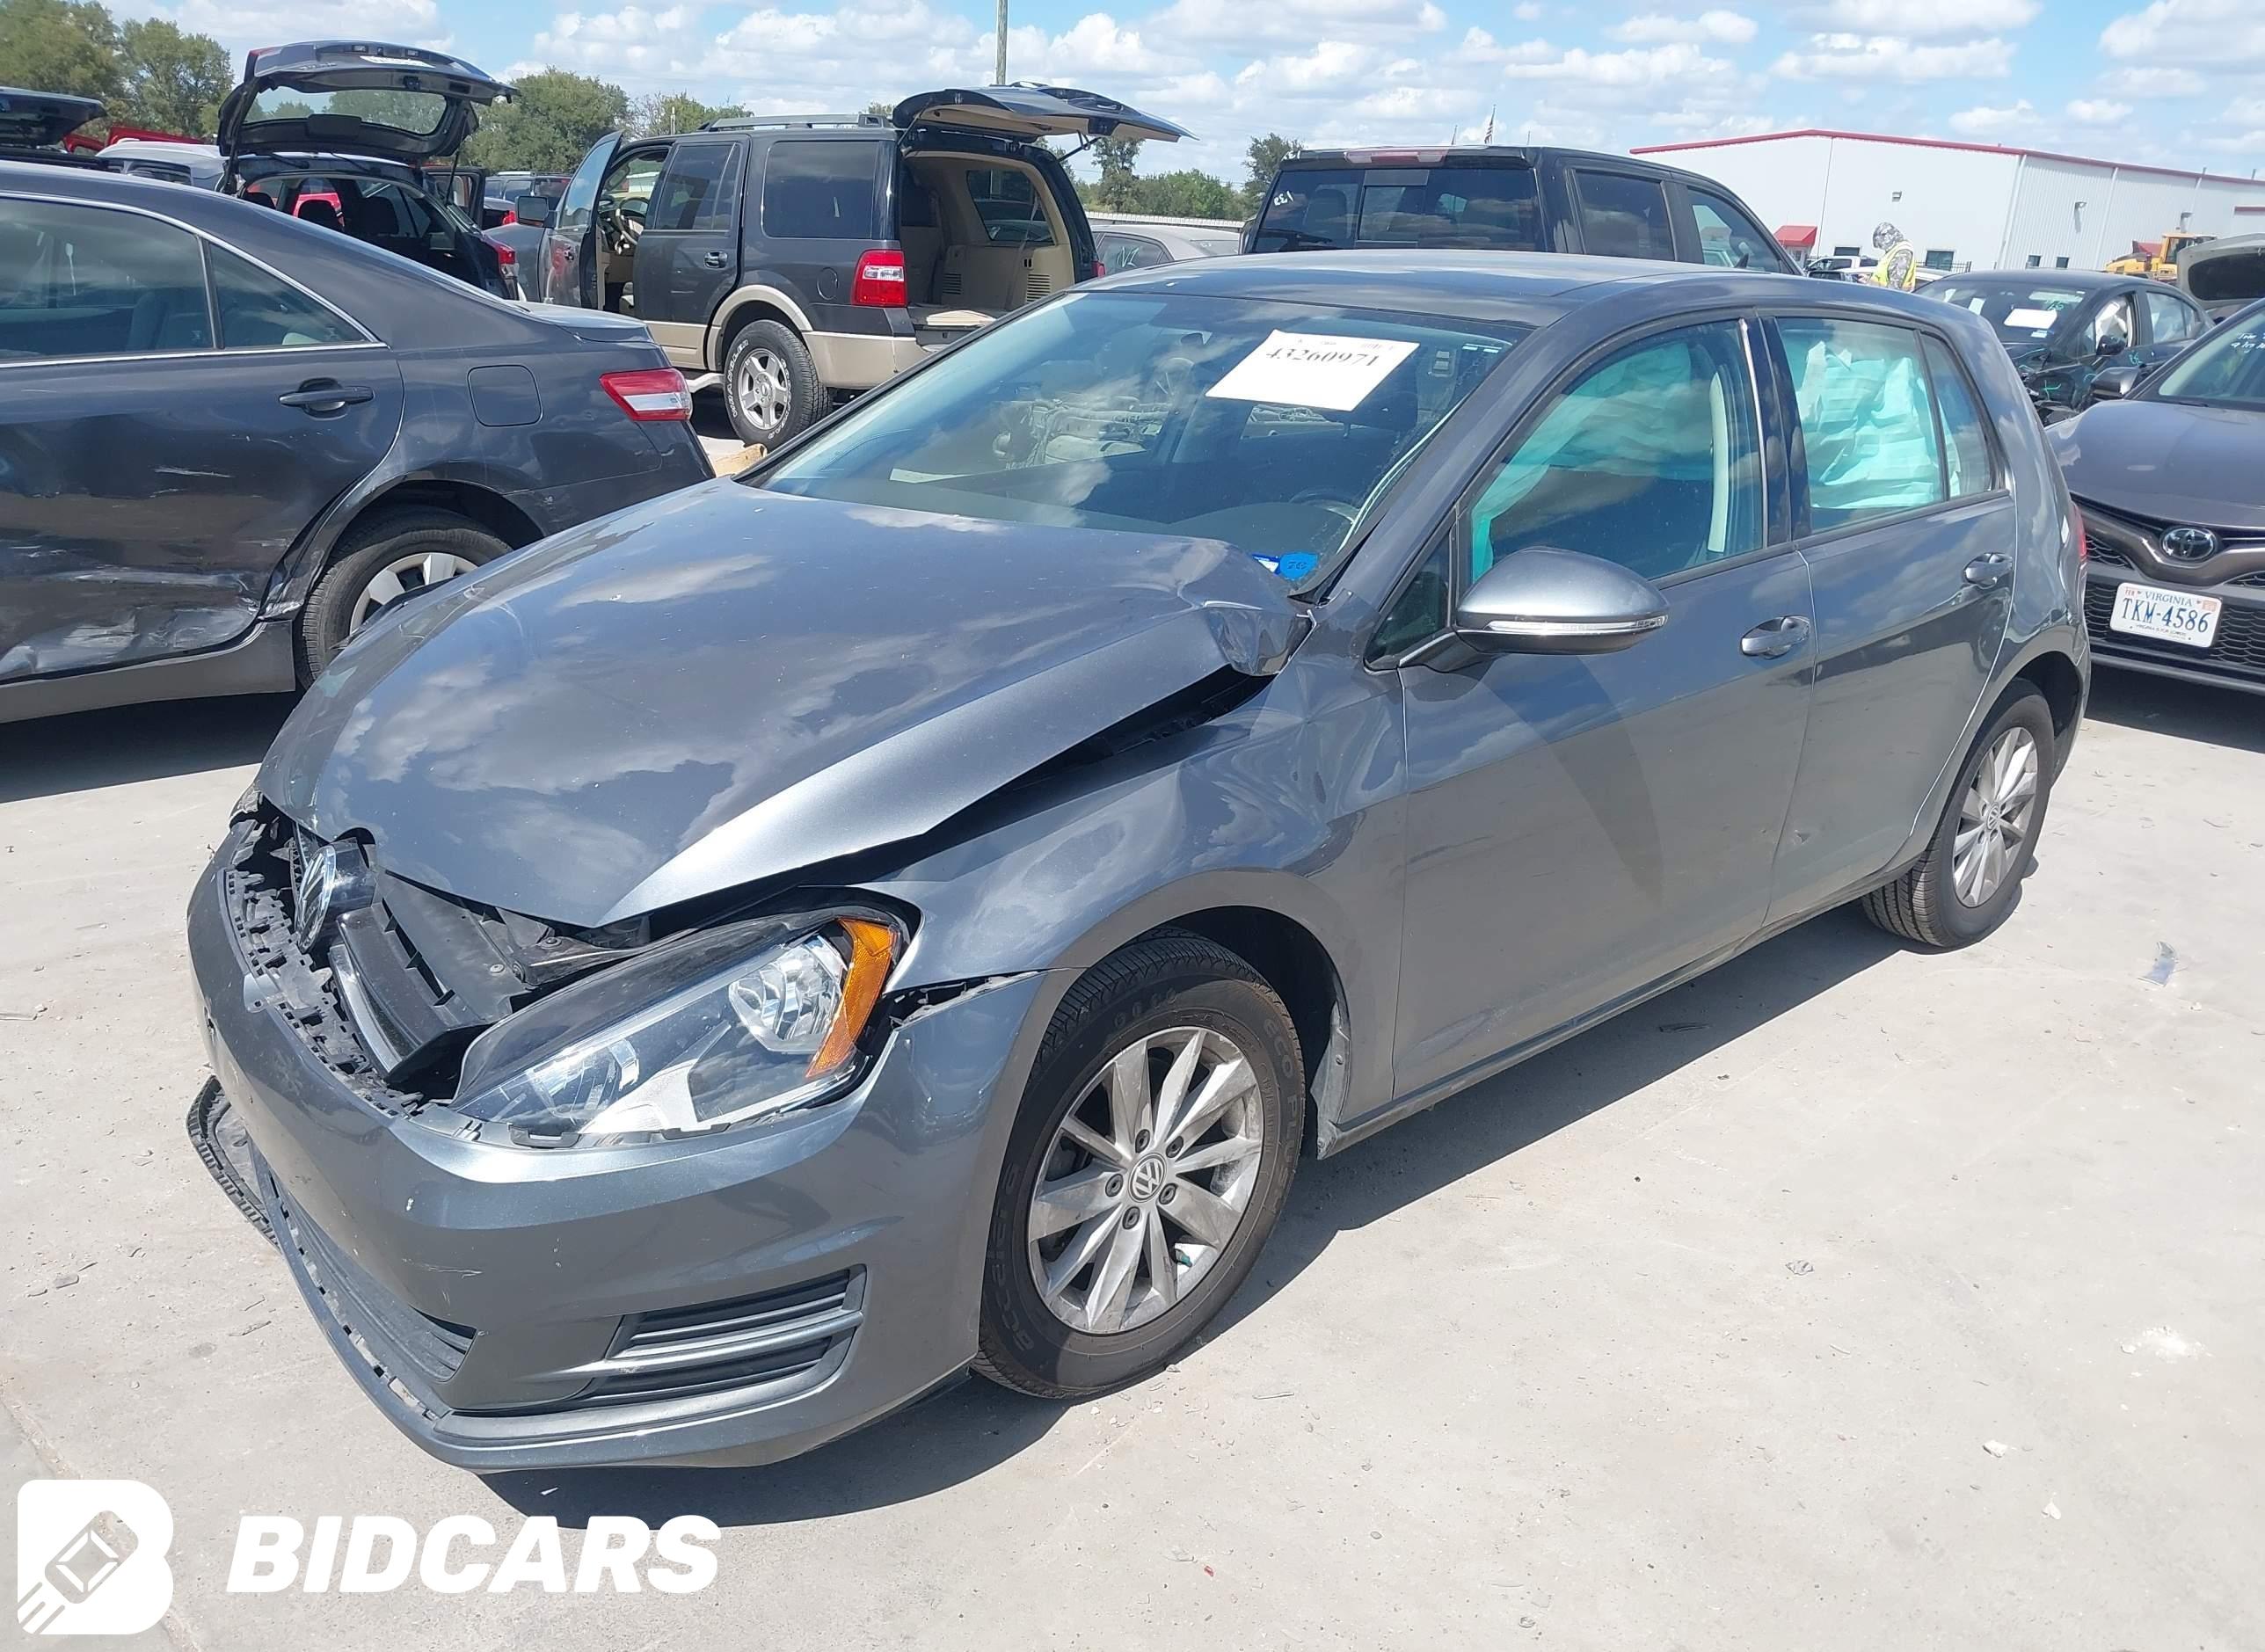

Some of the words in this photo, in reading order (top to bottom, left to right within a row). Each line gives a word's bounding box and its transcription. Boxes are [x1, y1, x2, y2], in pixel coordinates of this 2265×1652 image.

[1266, 347, 1380, 367] 43260971
[2145, 592, 2193, 607] VIRGINIA
[2123, 598, 2212, 633] TKM-4586
